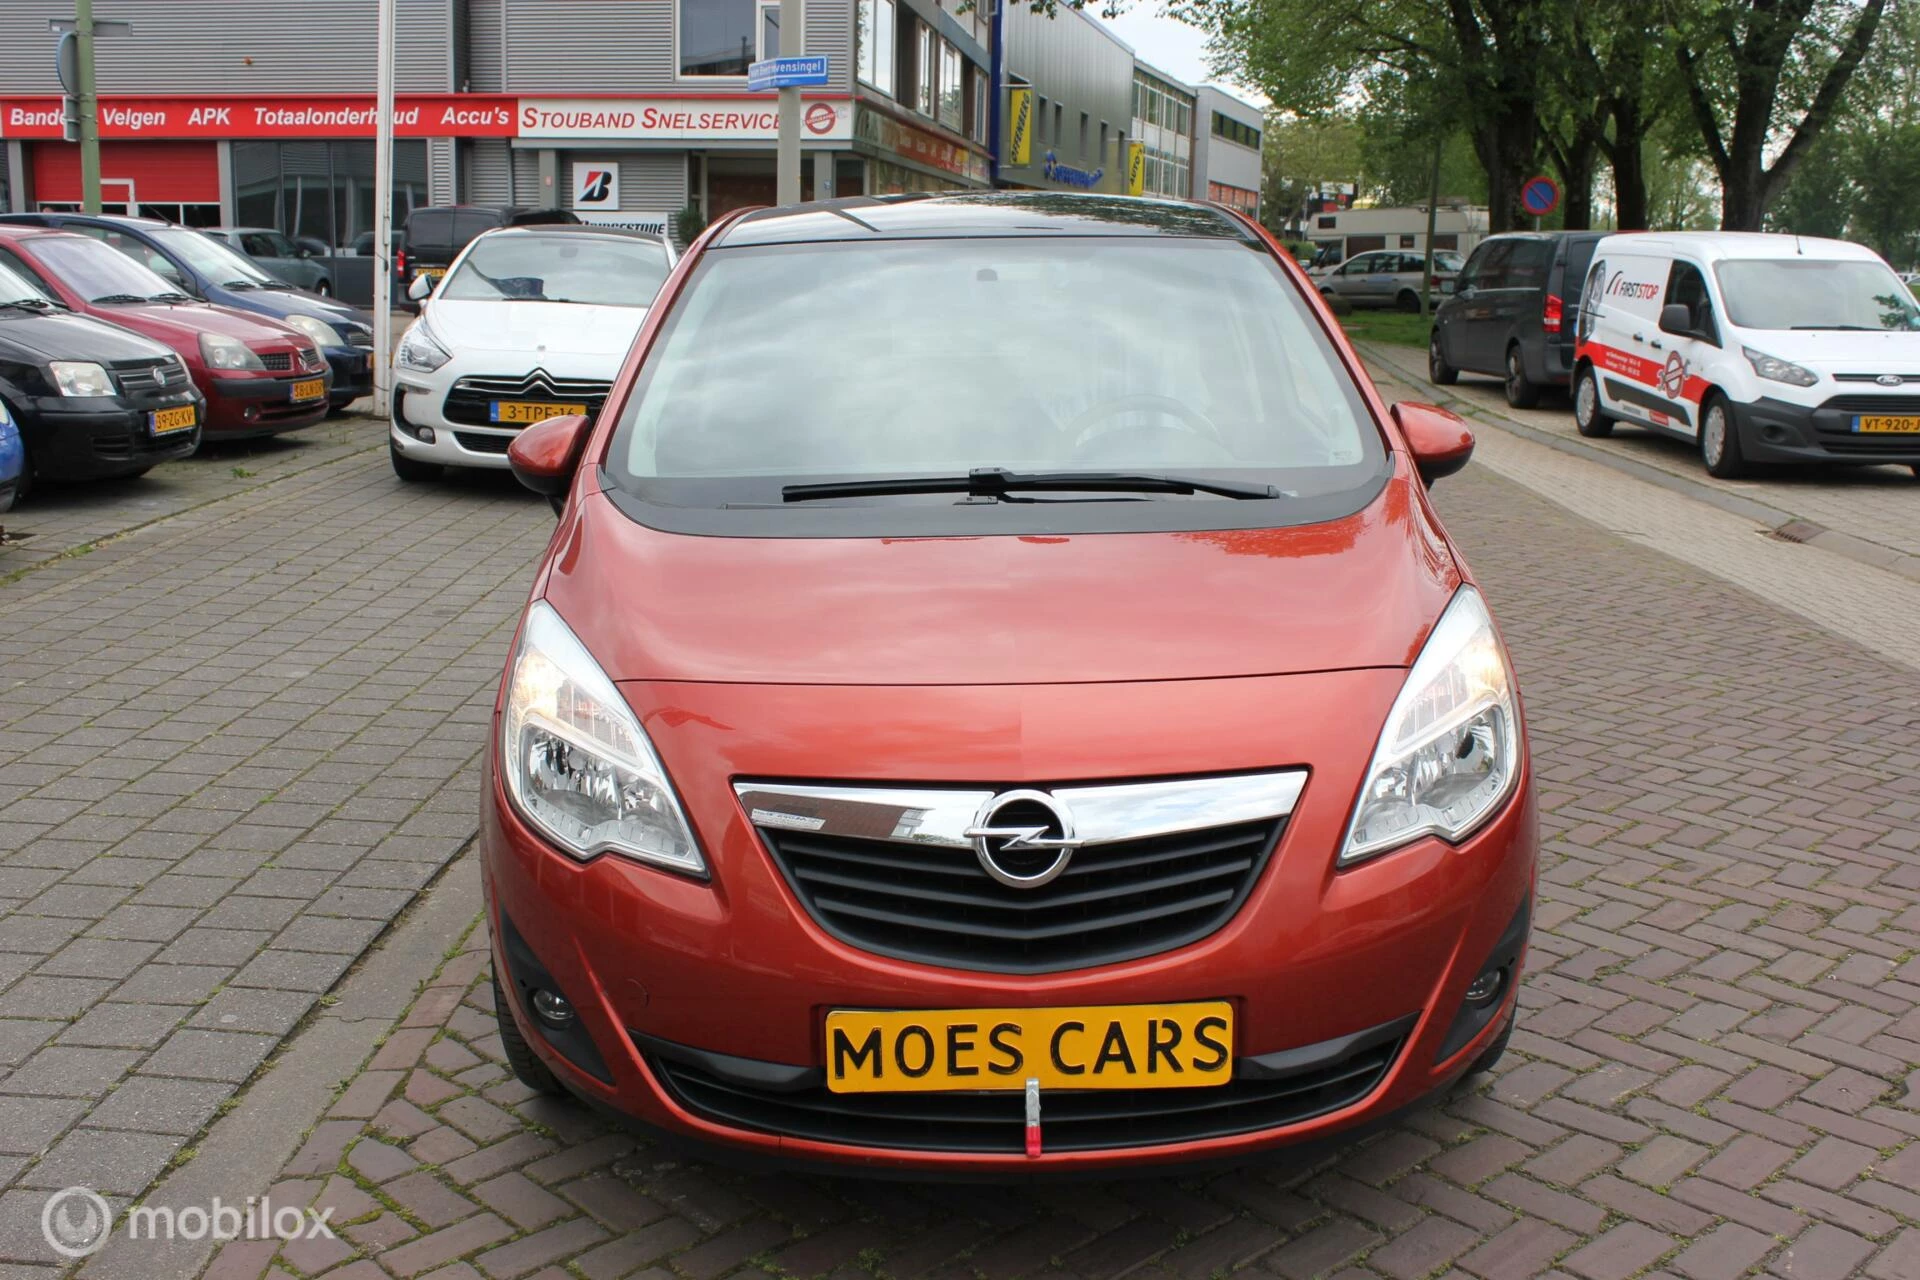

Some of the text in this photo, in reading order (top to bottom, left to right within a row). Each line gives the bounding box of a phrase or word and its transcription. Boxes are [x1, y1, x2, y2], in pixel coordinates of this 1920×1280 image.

[103, 108, 166, 130] Velgen
[187, 107, 231, 126] APK
[254, 107, 419, 126] Totaalonderhud
[440, 107, 509, 126] Accu's
[833, 1016, 1229, 1080] MOES CARS
